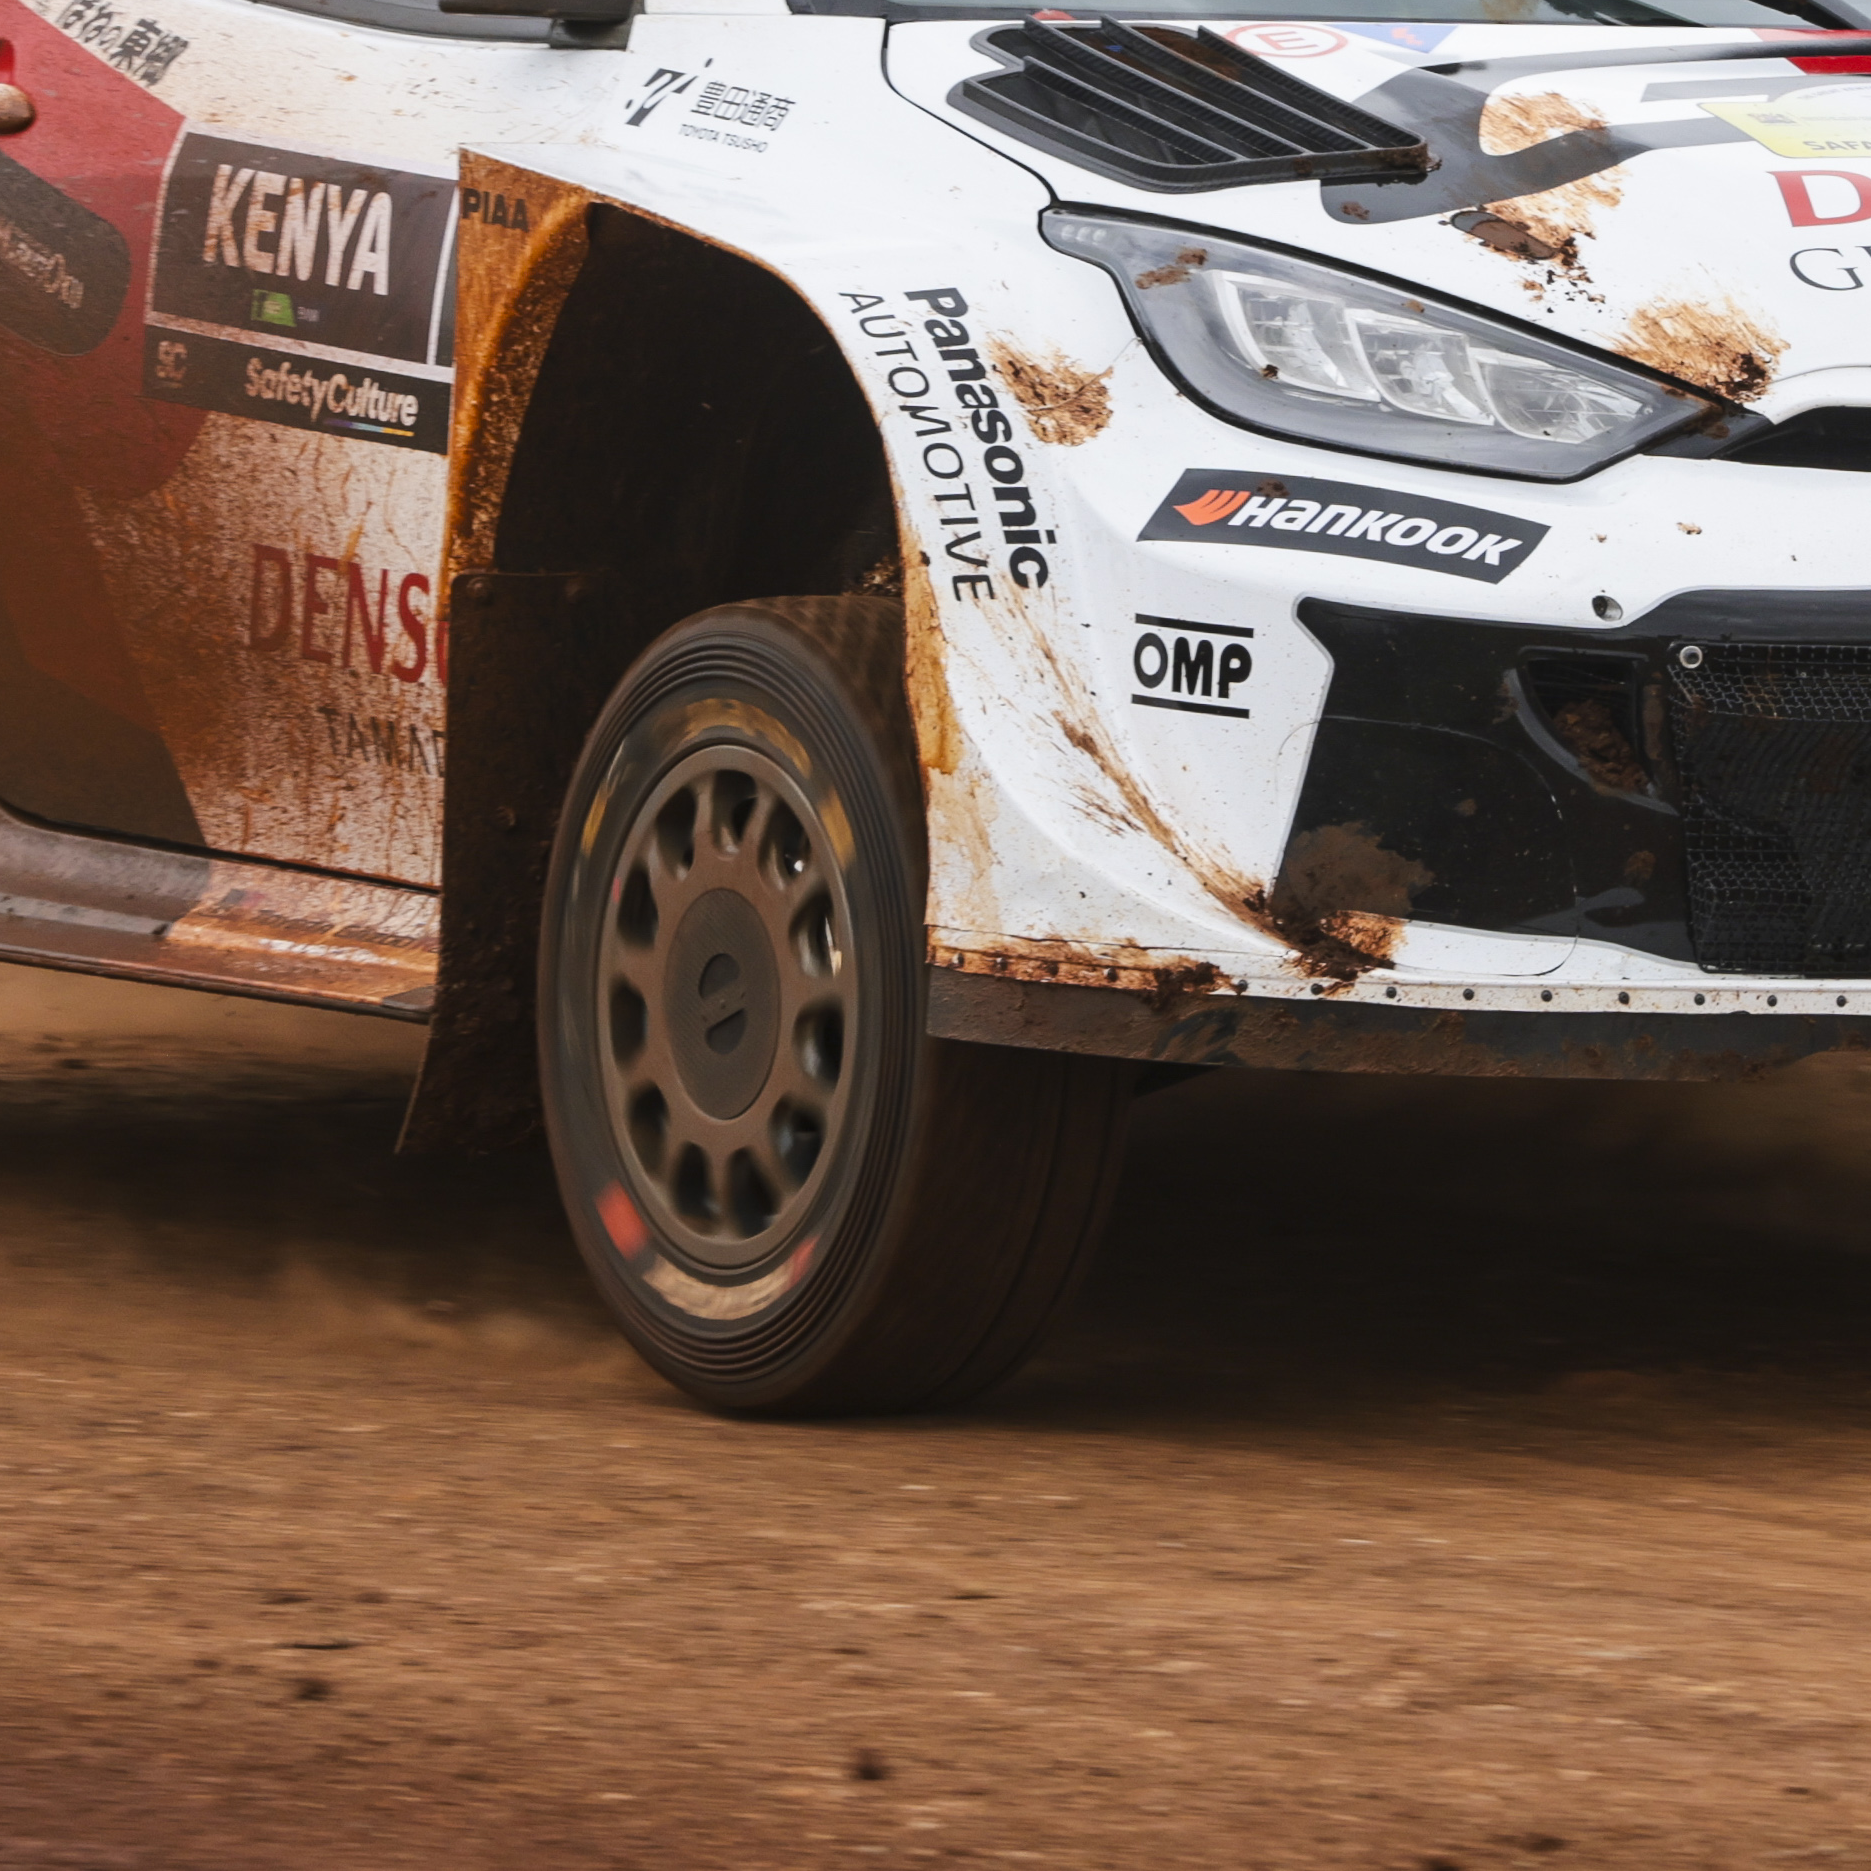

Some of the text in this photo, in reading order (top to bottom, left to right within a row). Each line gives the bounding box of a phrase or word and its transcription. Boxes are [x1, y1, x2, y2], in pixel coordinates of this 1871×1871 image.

[1255, 31, 1319, 51] E
[678, 123, 768, 154] TOYOTA TSUSHO
[202, 163, 394, 297] KENYA
[462, 187, 530, 233] PIAA
[244, 357, 419, 427] SafetyCulture
[838, 290, 995, 603] AUTOMOTIVE
[904, 287, 1057, 590] Panasonic
[1133, 632, 1253, 700] OMP
